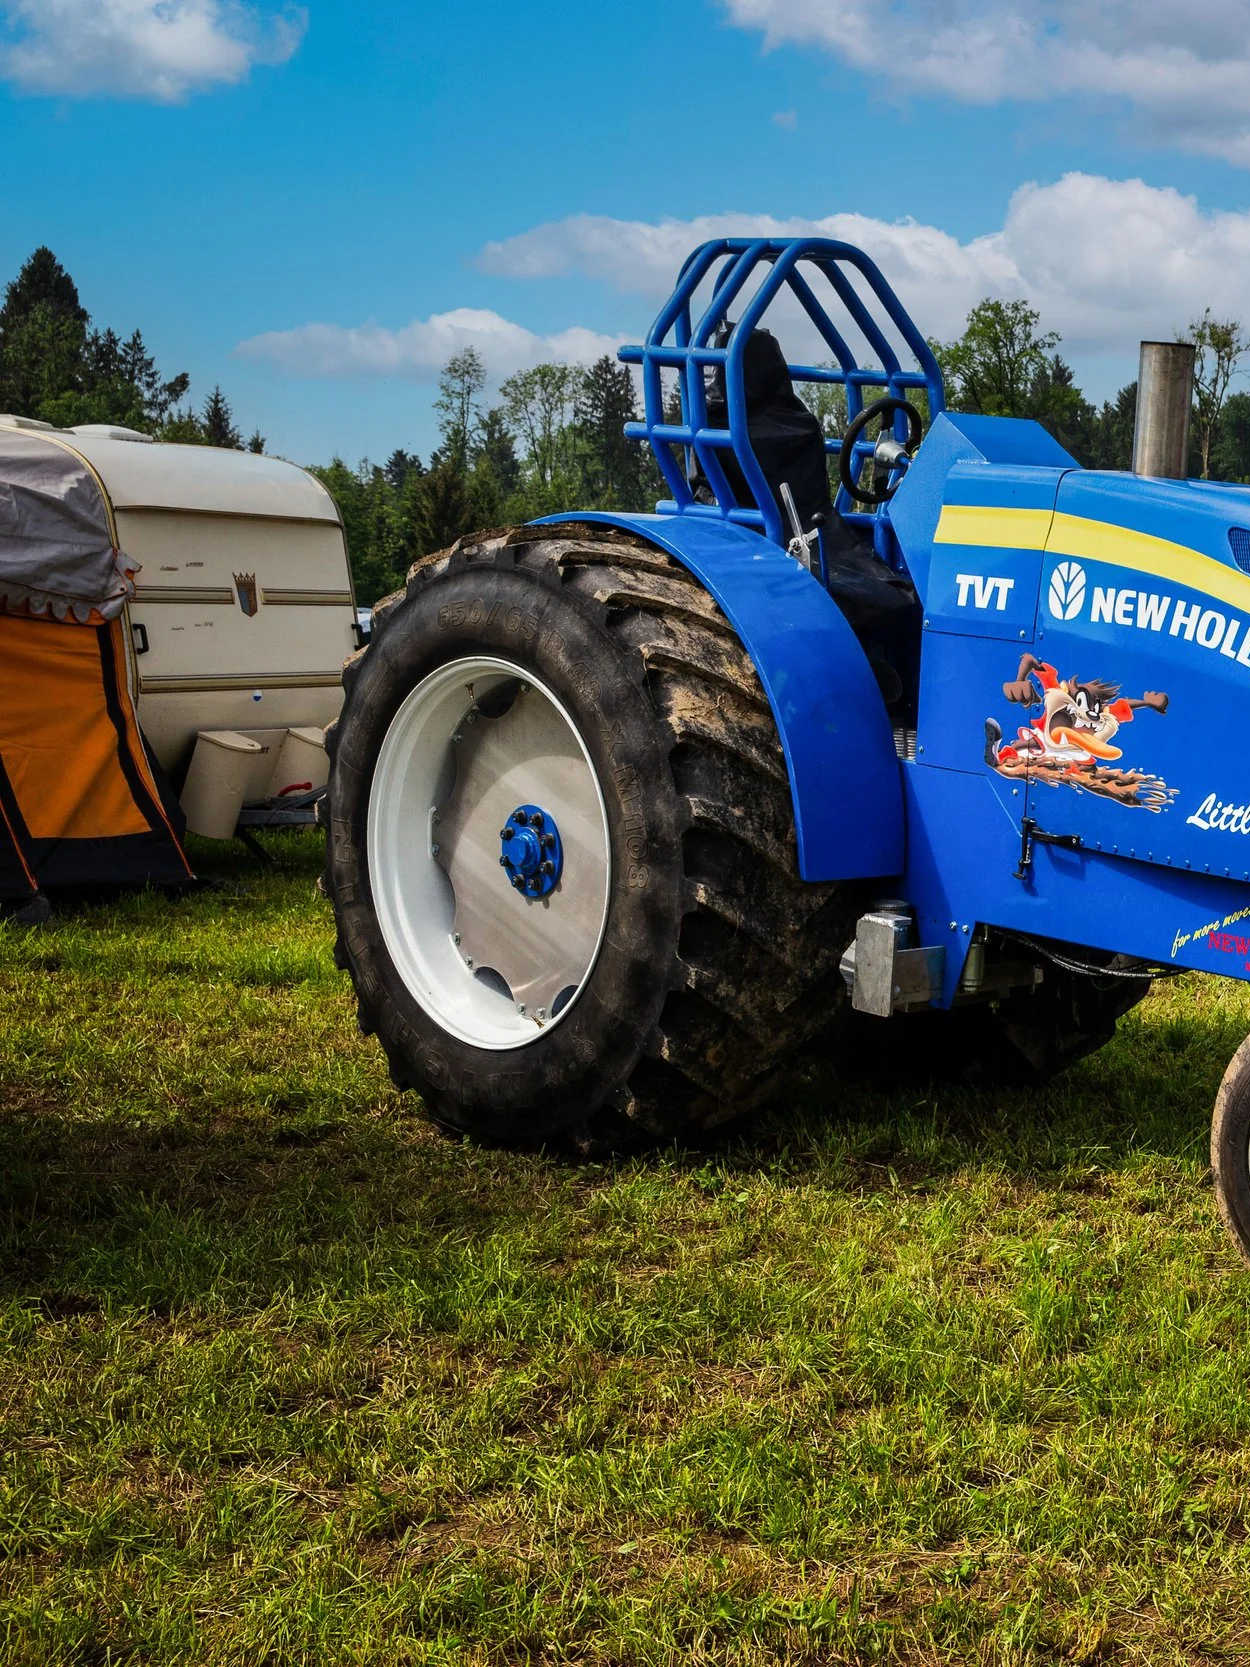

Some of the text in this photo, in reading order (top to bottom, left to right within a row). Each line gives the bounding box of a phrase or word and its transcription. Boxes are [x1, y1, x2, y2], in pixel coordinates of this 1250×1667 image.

[956, 573, 1014, 610] TVT
[1090, 586, 1171, 631] NEW
[1171, 929, 1191, 958] for
[1193, 920, 1220, 942] more
